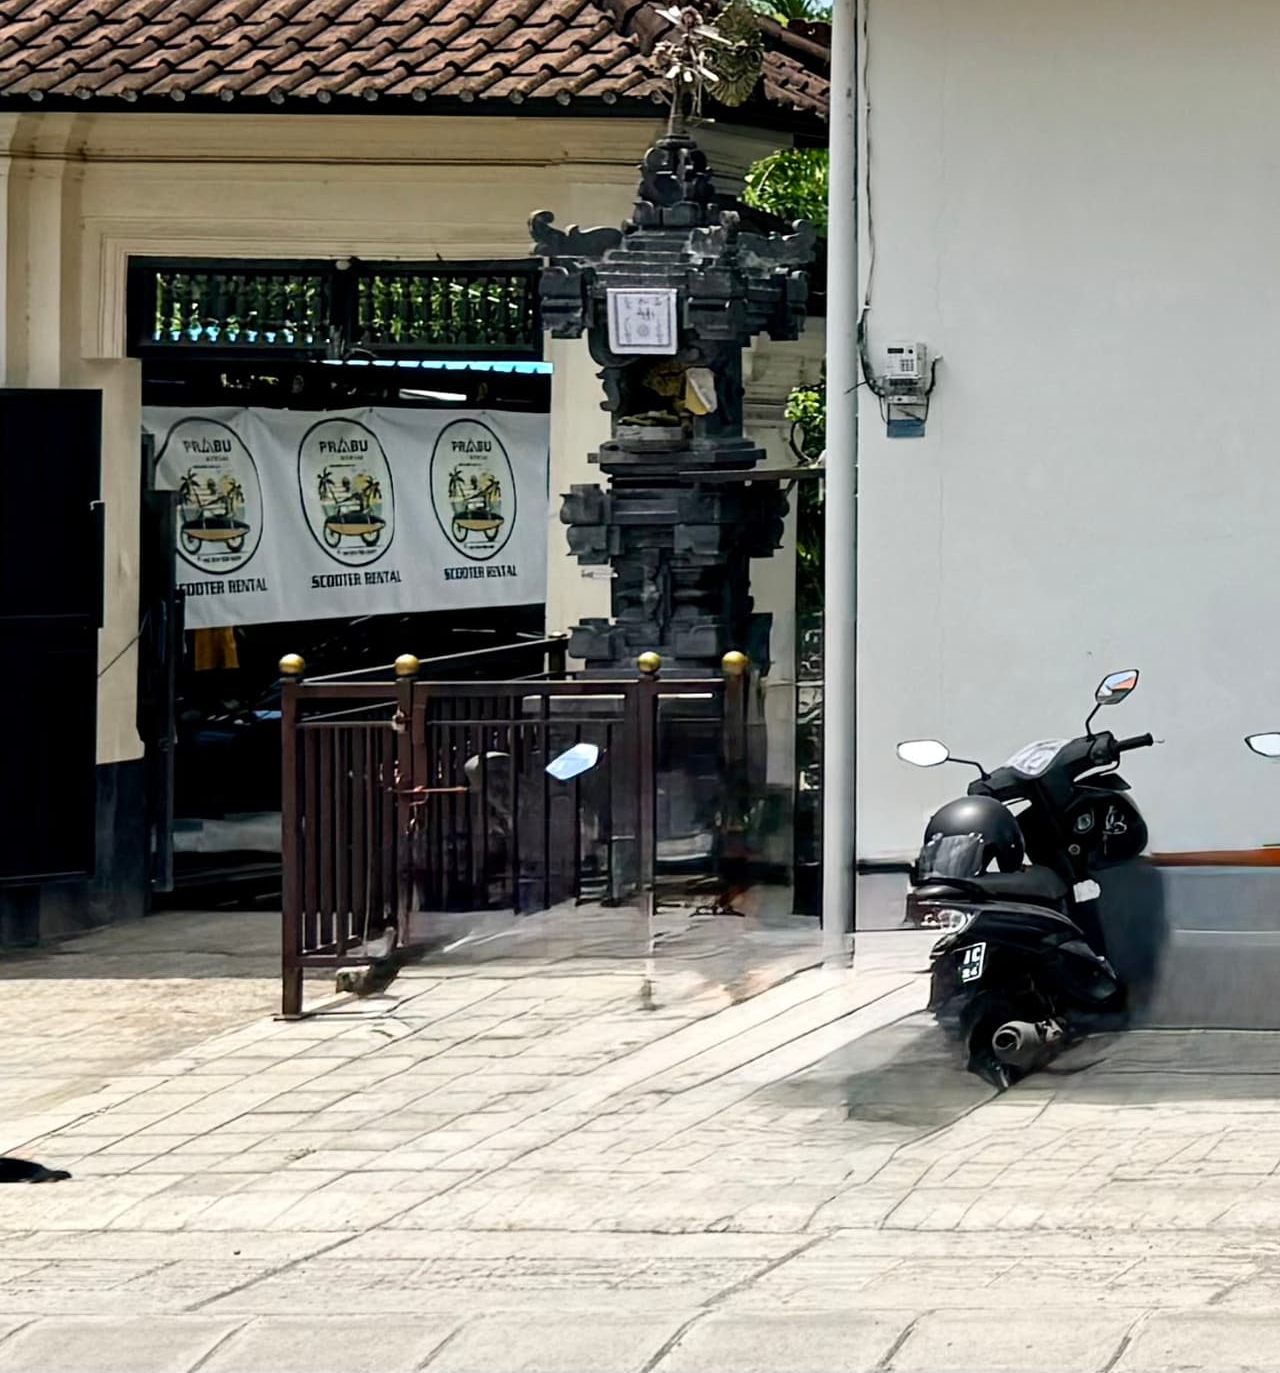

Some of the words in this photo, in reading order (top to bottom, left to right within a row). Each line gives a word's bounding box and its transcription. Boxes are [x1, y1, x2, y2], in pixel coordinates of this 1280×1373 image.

[183, 437, 232, 454] PRABU
[319, 438, 368, 453] PRABU
[451, 439, 492, 453] PRABU
[311, 572, 362, 589] SCOOTER
[365, 570, 402, 585] RENTAL
[444, 565, 485, 581] SCOOTER
[486, 563, 518, 578] RENTAL
[228, 577, 268, 596] RENTAL
